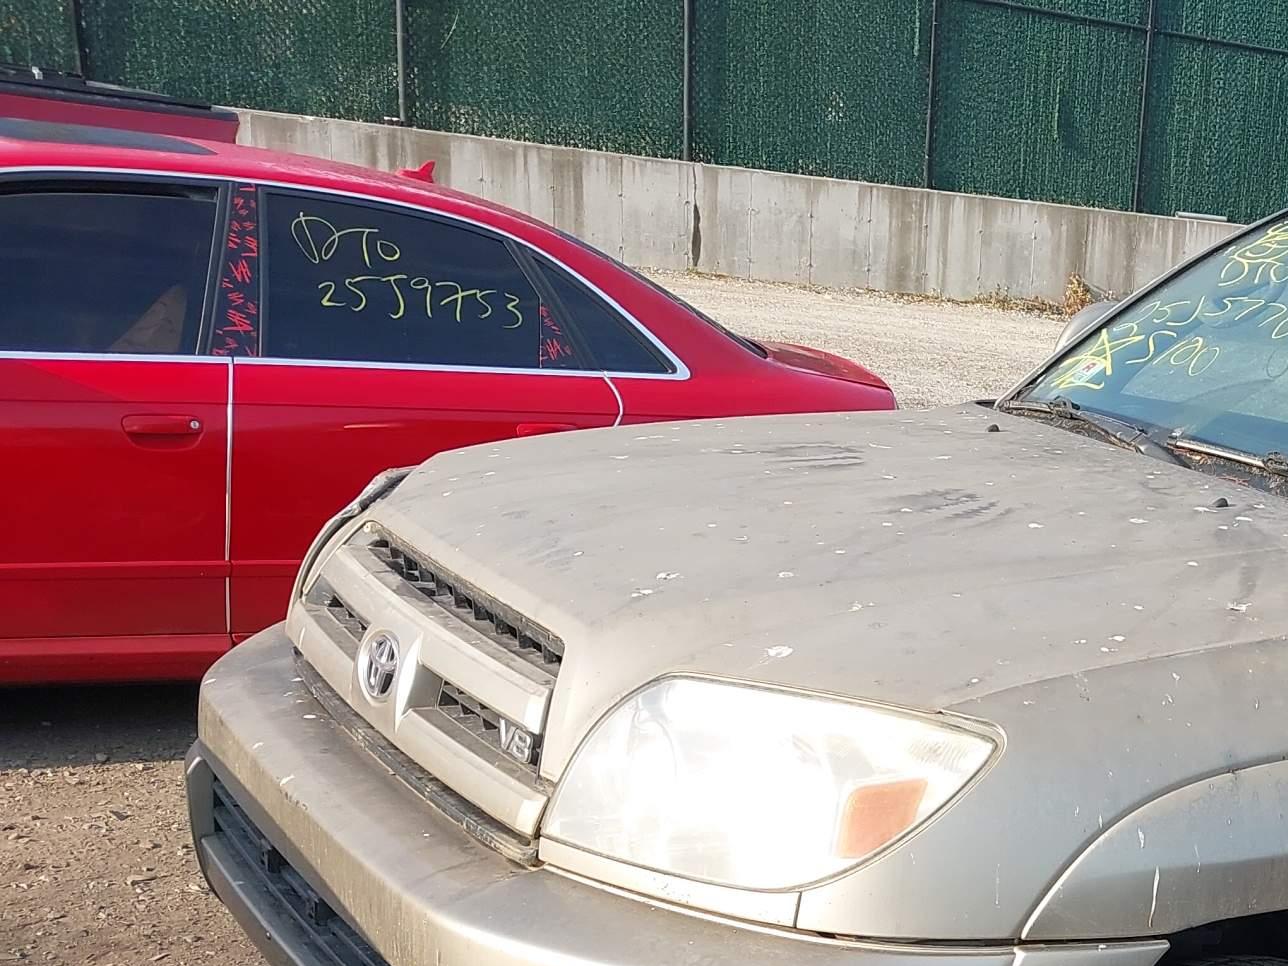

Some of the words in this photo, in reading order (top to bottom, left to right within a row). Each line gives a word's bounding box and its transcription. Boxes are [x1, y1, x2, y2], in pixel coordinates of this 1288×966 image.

[291, 212, 400, 268] DTO
[318, 274, 523, 329] 25J9753
[499, 717, 533, 764] V8
